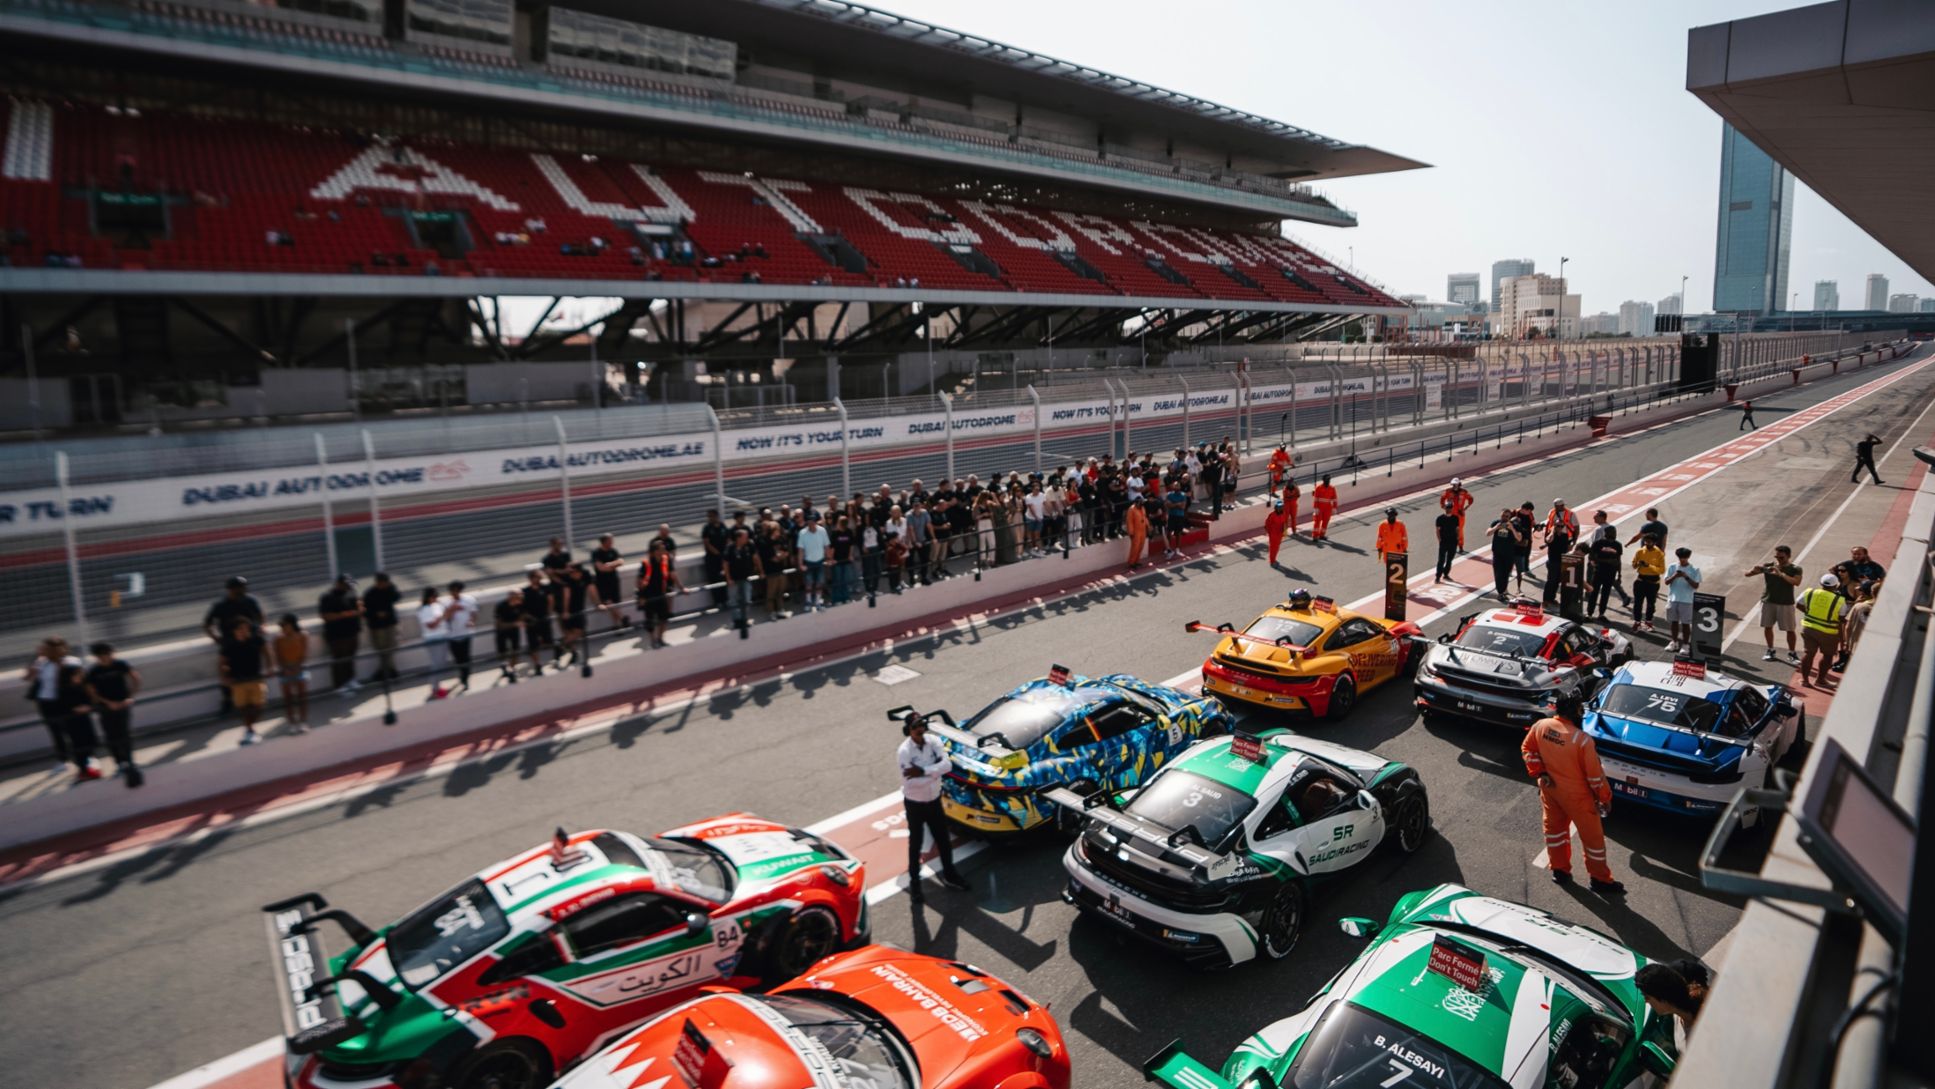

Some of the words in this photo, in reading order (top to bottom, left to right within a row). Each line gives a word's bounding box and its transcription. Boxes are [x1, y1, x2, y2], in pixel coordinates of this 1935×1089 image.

[1052, 409, 1075, 420] NOW
[1076, 406, 1093, 418] IT'S
[736, 436, 773, 450] NOW
[777, 435, 802, 446] IT'S
[848, 427, 883, 439] TURN
[908, 421, 945, 434] DUBAI
[182, 481, 268, 505] DUBAI
[1389, 563, 1404, 584] 2
[1566, 566, 1578, 588] 1
[1697, 606, 1719, 633] 3
[1351, 653, 1398, 668] DELIVERING
[1647, 697, 1678, 713] 75
[1182, 792, 1204, 808] 3
[1333, 824, 1355, 841] SR
[1309, 840, 1370, 867] SAUDIRACING
[717, 926, 739, 949] 84
[1429, 957, 1452, 975] Don't
[1452, 968, 1479, 987] Touch
[1432, 946, 1452, 963] Parc
[1452, 956, 1480, 976] Fermé
[618, 954, 702, 993] الكويت
[869, 965, 939, 1010] BAHRAIN
[1373, 1034, 1387, 1049] B.
[1387, 1043, 1446, 1079] ALESAYI
[1380, 1058, 1414, 1089] 7
